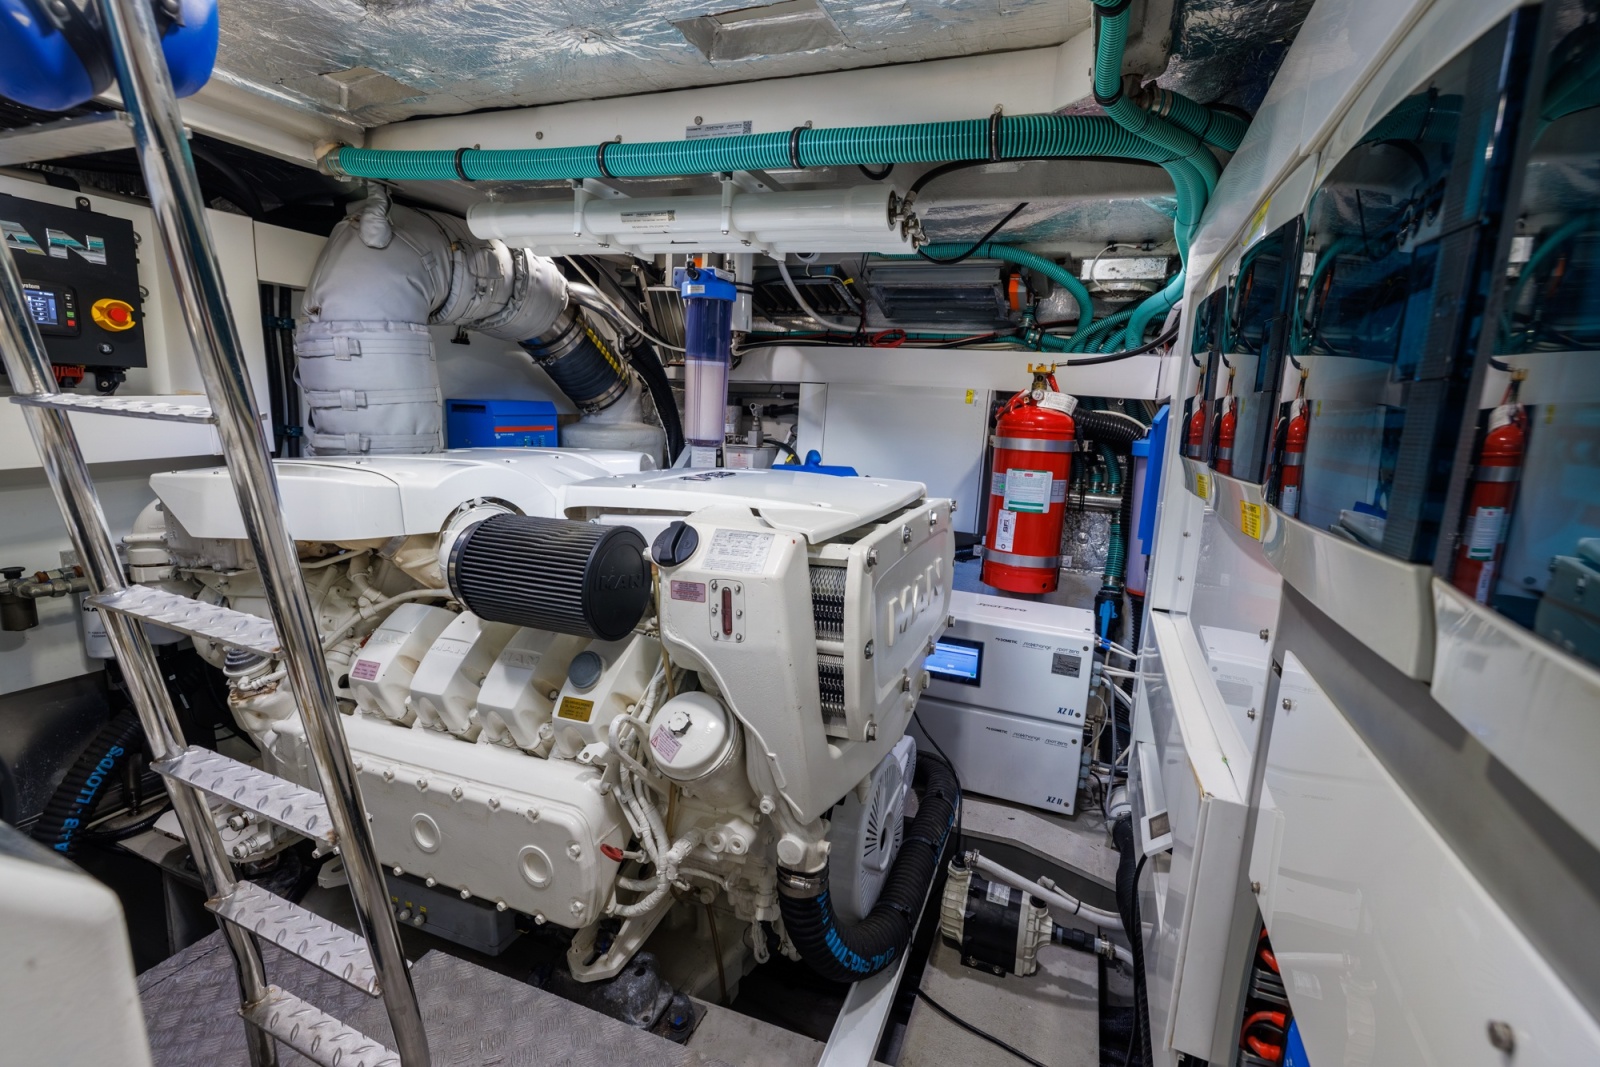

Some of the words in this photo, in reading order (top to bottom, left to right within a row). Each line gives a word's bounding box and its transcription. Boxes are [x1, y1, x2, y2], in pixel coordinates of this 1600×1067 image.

[0, 220, 107, 265] AN
[600, 573, 643, 592] MAN
[888, 557, 942, 647] MAN
[1057, 707, 1067, 715] XZ
[54, 818, 80, 853] A+B
[75, 745, 125, 804] LLOYD'S
[1046, 796, 1056, 804] XZ
